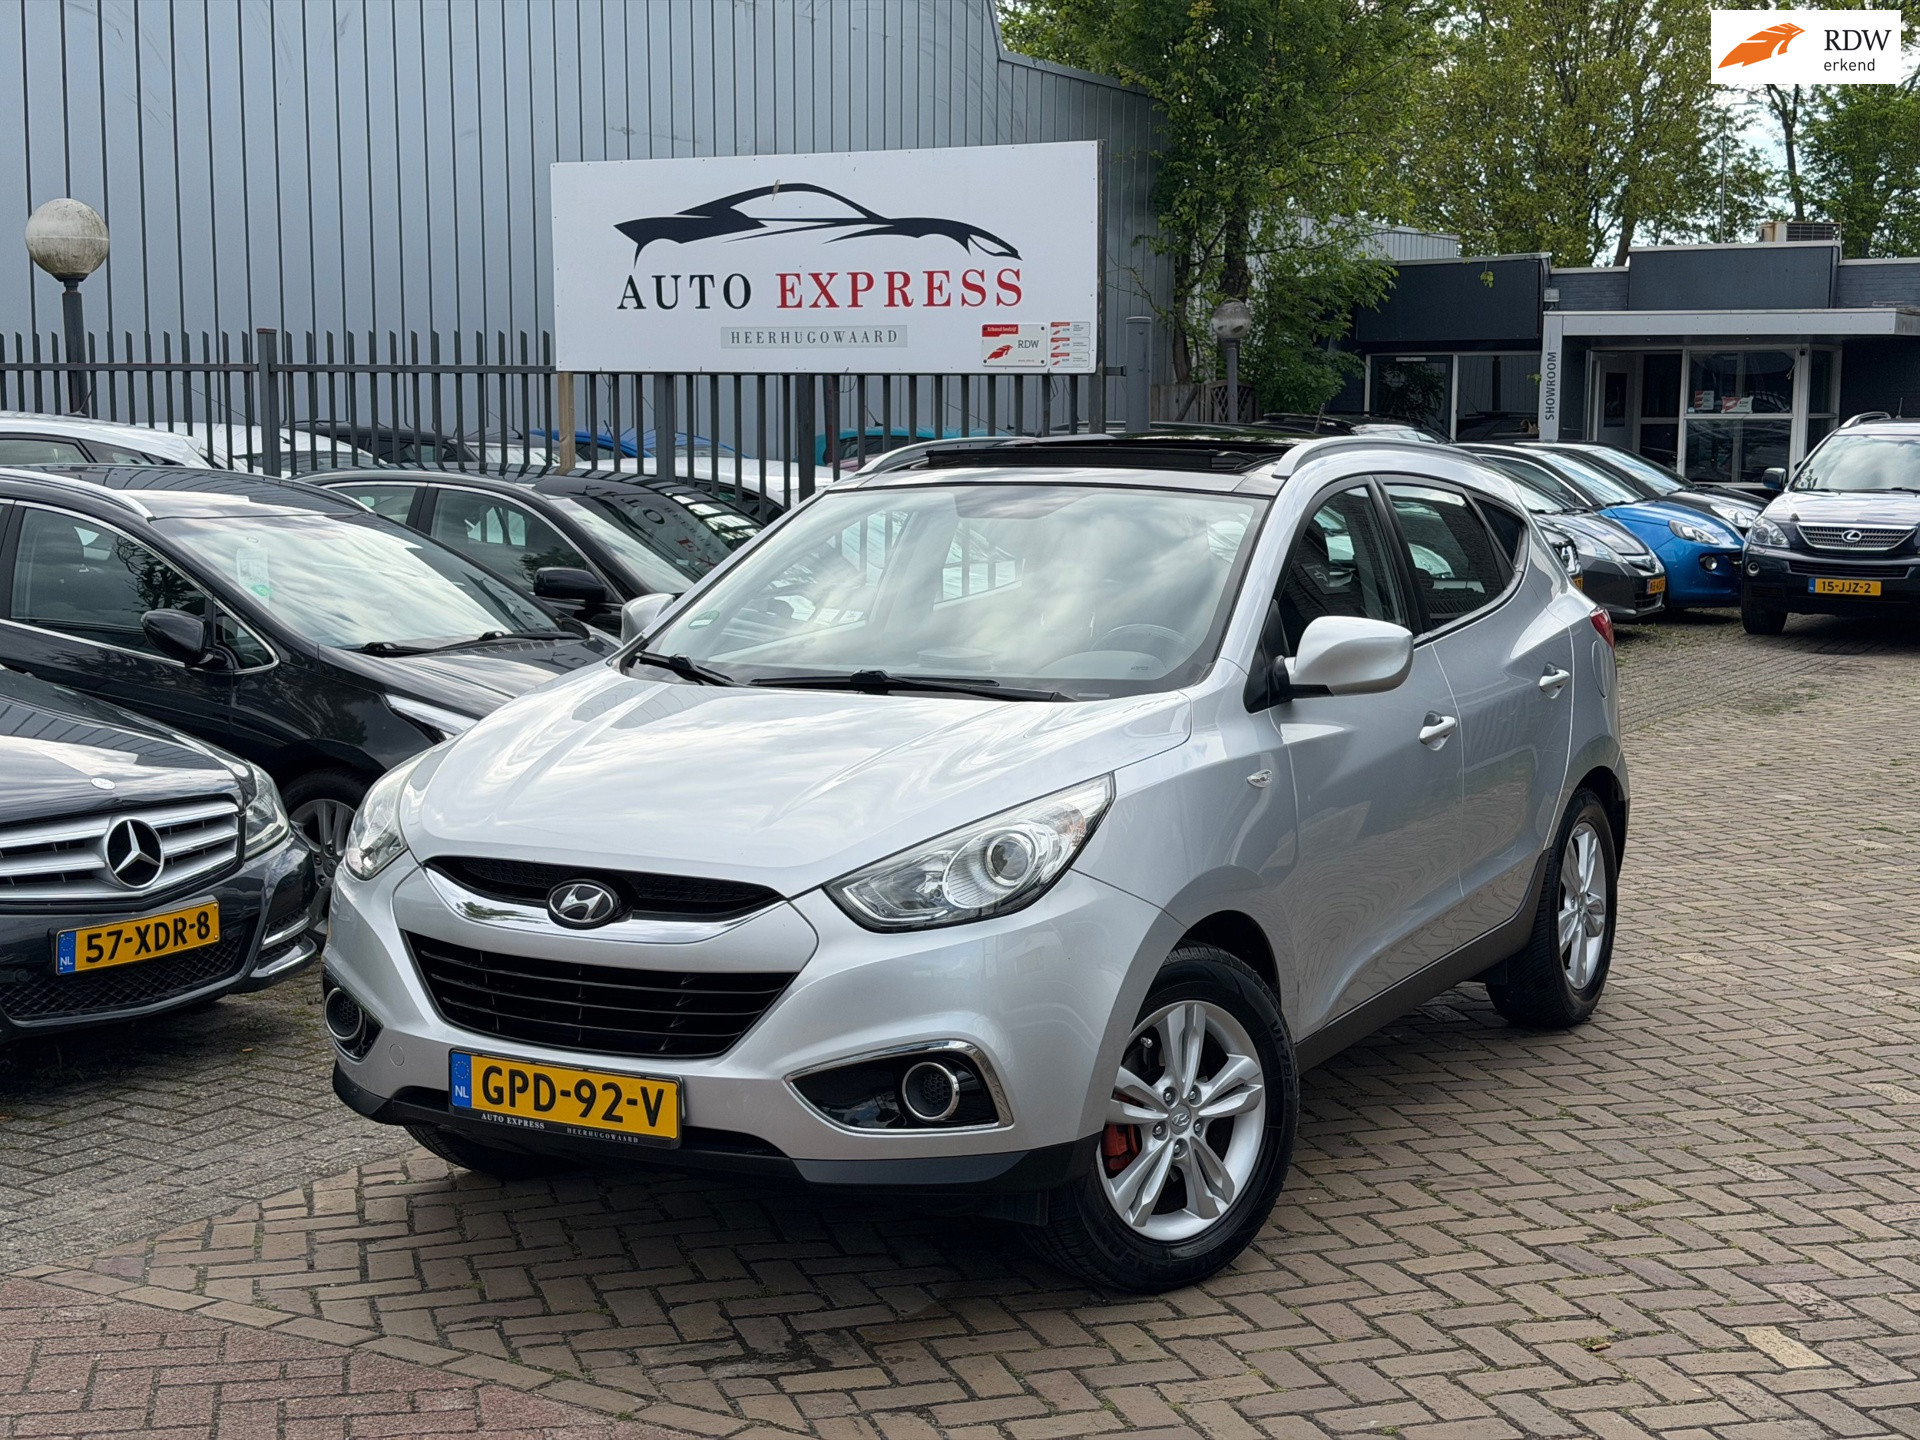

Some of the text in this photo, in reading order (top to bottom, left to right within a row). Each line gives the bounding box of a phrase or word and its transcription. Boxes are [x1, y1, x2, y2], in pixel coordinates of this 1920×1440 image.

[616, 267, 1024, 310] AUTO EXPRESS
[730, 329, 899, 345] HEERHUGOWAARD
[1017, 340, 1039, 348] RDW
[1545, 352, 1556, 420] SHOWROOM
[1822, 581, 1871, 593] 15-JJZ-2
[60, 911, 210, 966] NL 57-XDR-8
[454, 1065, 665, 1128] NL GPD-92-V
[481, 1111, 639, 1143] AUTO EXPRESS HEERHUGOWAARD
